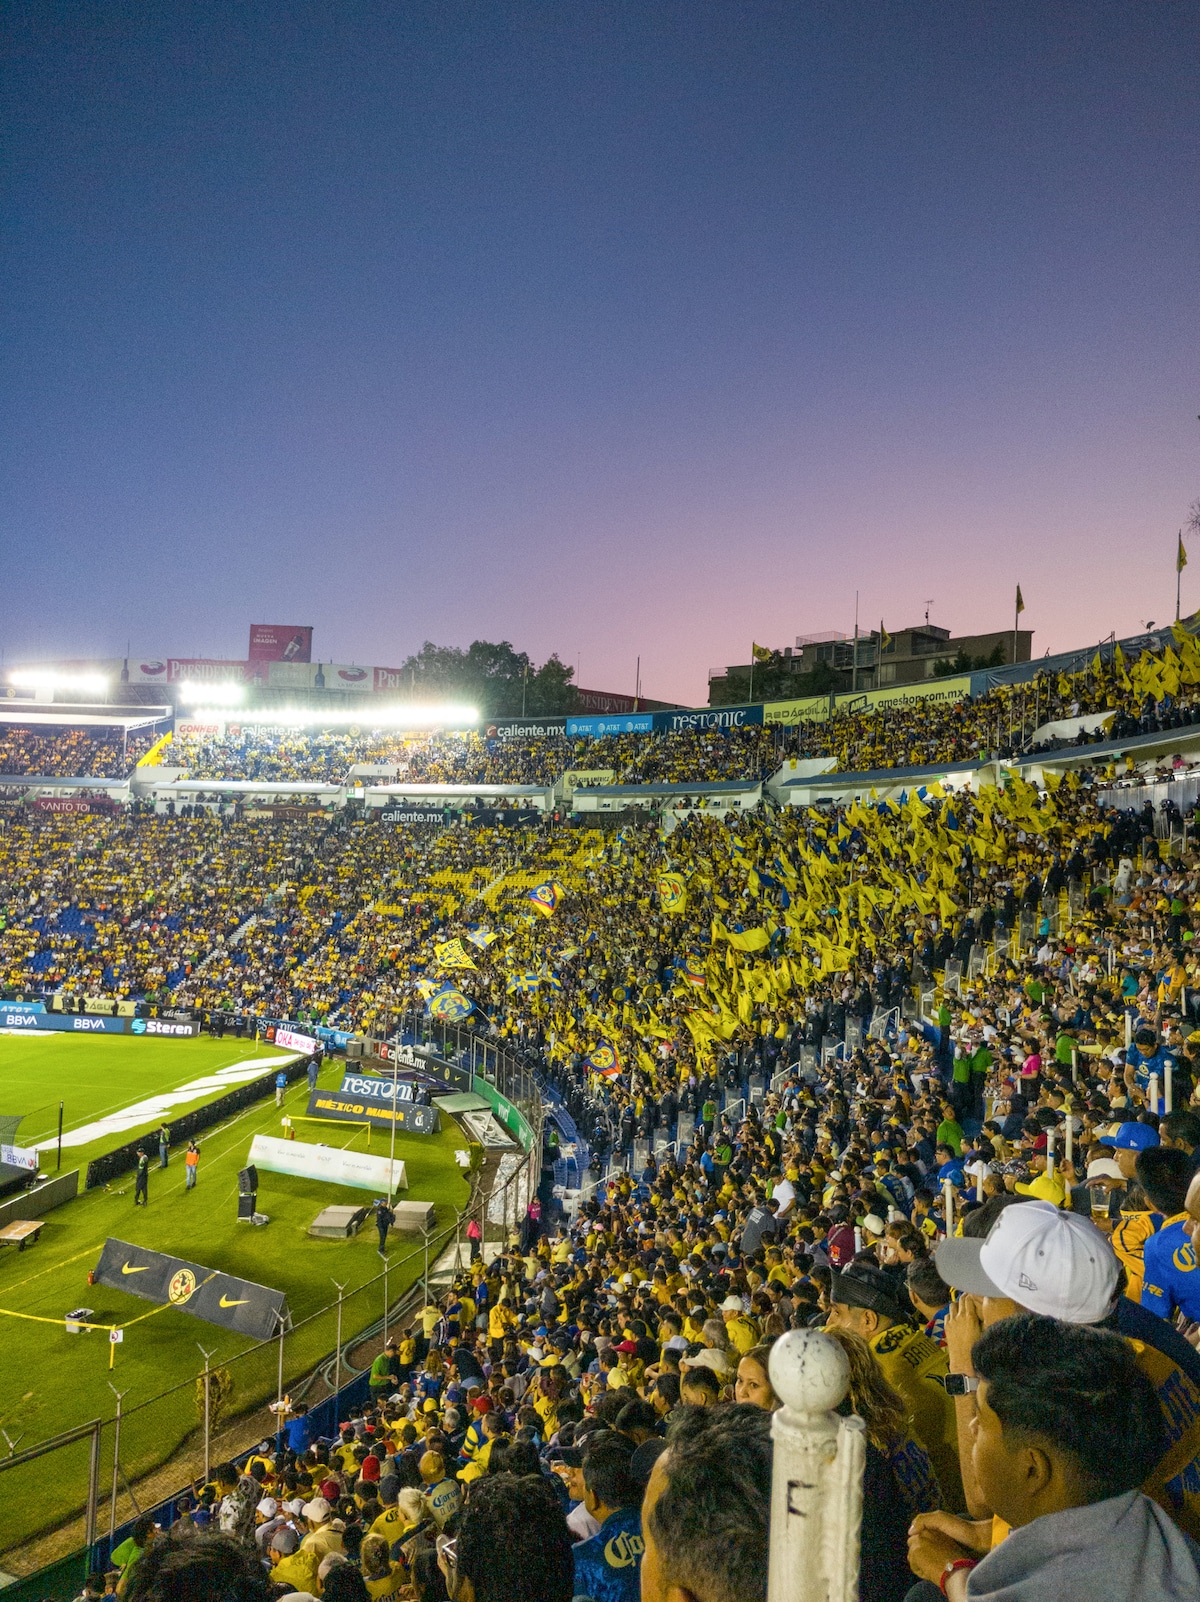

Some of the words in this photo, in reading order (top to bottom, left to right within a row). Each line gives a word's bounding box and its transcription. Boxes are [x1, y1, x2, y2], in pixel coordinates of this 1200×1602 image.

[579, 692, 629, 713] RESIDENTE
[179, 723, 220, 734] GONHER
[496, 723, 566, 738] caliente.mx
[577, 724, 593, 732] AT&T
[605, 723, 621, 731] AT&T
[633, 722, 649, 730] AT&T
[40, 800, 74, 812] SANTO
[381, 810, 444, 823] caliente.mx
[6, 1015, 37, 1026] BBVA
[73, 1018, 105, 1030] BBVA
[146, 1021, 193, 1035] Steren
[315, 1098, 364, 1114] MÉXICO
[7, 1153, 26, 1165] BBVA
